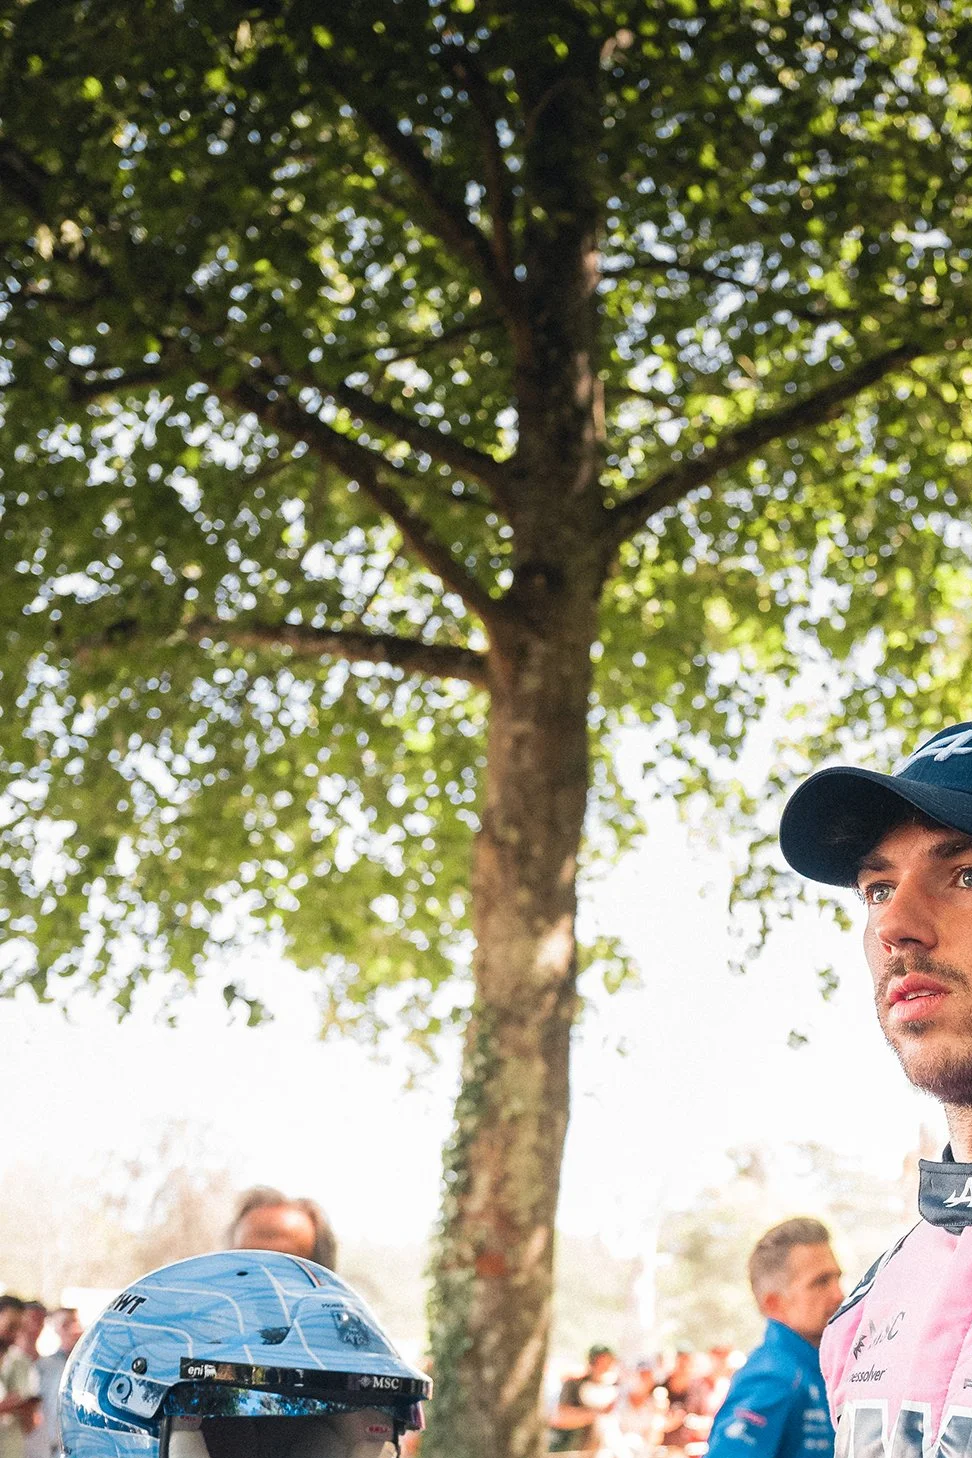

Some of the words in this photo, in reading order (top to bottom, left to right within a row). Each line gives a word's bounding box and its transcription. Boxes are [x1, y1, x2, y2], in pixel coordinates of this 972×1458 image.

[110, 1293, 147, 1315] WT
[187, 1365, 204, 1378] eni
[848, 1364, 888, 1382] essolver
[372, 1376, 400, 1390] MSC
